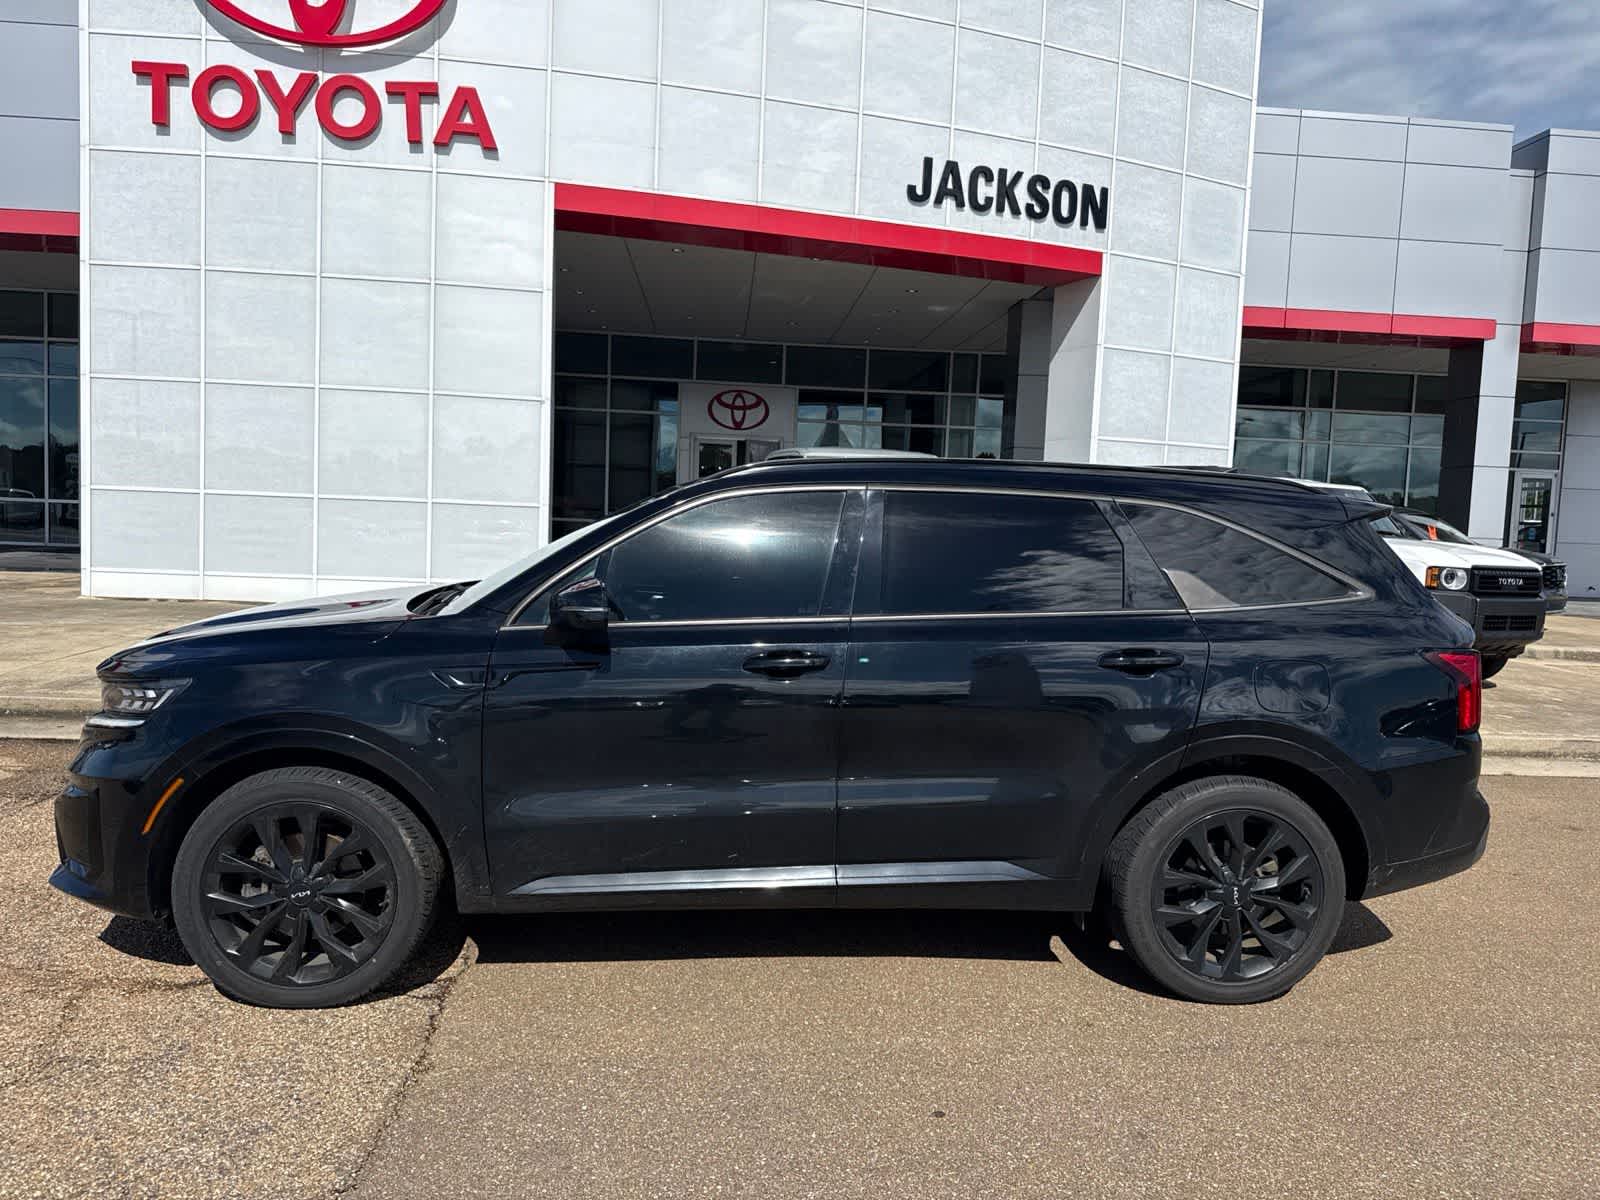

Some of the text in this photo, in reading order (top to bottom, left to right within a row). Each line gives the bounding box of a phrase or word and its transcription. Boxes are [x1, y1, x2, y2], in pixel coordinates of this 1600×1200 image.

[131, 60, 499, 152] TOYOTA
[906, 156, 1109, 230] JACKSON
[1498, 577, 1524, 586] TOYOTA
